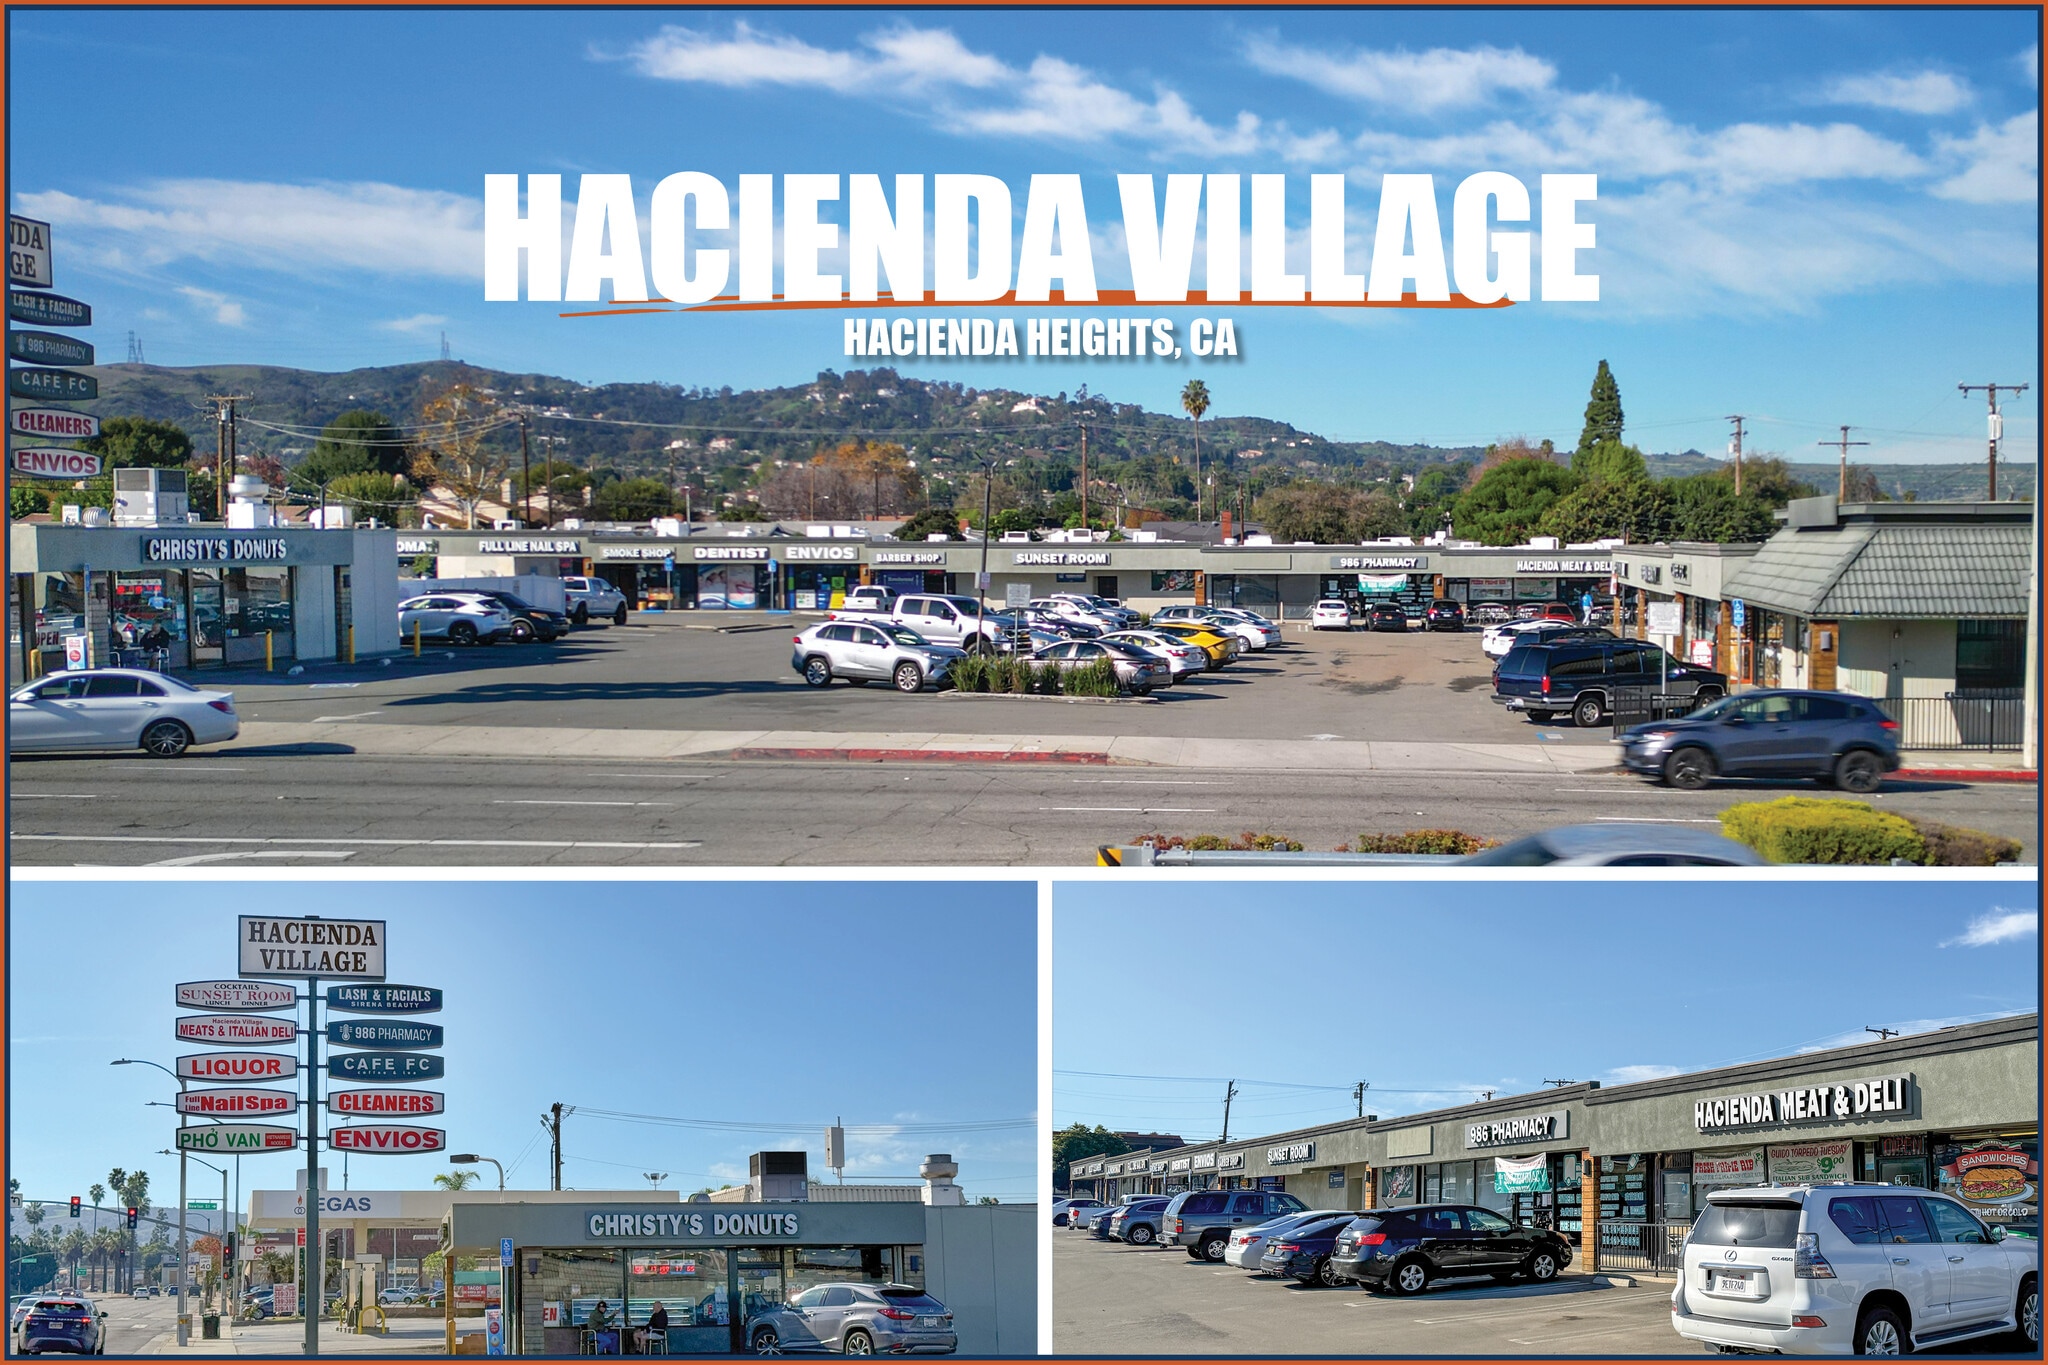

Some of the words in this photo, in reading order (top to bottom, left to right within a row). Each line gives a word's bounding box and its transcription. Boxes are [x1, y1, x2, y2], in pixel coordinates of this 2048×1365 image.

[13, 293, 36, 309] LASH
[39, 298, 46, 311] &
[49, 299, 83, 317] FACIALS
[28, 337, 44, 353] 986
[45, 341, 87, 360] PHARMACY
[21, 371, 61, 389] CAFE
[69, 377, 87, 392] FC
[19, 411, 93, 436] CLEANERS
[17, 451, 97, 474] ENVIOS
[149, 538, 228, 561] CHRISTY'S
[234, 538, 287, 559] DONUTS
[479, 541, 504, 552] FULL
[506, 541, 528, 552] LINE
[530, 541, 554, 552] NAIL
[556, 541, 577, 552] SPA
[602, 547, 640, 558] SMOKE
[641, 548, 671, 558] SHOP
[694, 547, 769, 559] DENTIST
[785, 547, 855, 560] ENVIOS
[876, 553, 912, 563] BARBER
[914, 553, 940, 563] SHOP
[1016, 553, 1065, 564] SUNSET
[1068, 553, 1107, 564] ROOM
[1340, 557, 1360, 568] 986
[1362, 557, 1417, 568] PHARMACY
[1517, 560, 1559, 571] HACIENDA
[1561, 560, 1584, 571] MEAT
[1585, 561, 1592, 571] &
[248, 921, 378, 946] HACIENDA
[259, 948, 367, 973] VILLAGE
[214, 983, 260, 991] COCKTAILS
[181, 989, 243, 1001] SUNSET
[247, 991, 291, 1002] ROOM
[338, 988, 368, 1001] LASH
[373, 989, 381, 1001] &
[386, 989, 431, 1002] FACIALS
[180, 1024, 215, 1037] MEATS
[218, 1025, 225, 1037] &
[229, 1025, 268, 1038] ITALIAN
[271, 1026, 294, 1038] DELI
[355, 1027, 376, 1039] 986
[378, 1027, 433, 1041] PHARMACY
[192, 1059, 282, 1076] LIQUOR
[343, 1057, 395, 1070] CAFE
[406, 1059, 430, 1071] FC
[185, 1095, 200, 1103] Full
[338, 1094, 434, 1112] CLEANERS
[1694, 1094, 1774, 1128] HACIENDA
[1779, 1087, 1829, 1120] MEAT
[1833, 1085, 1850, 1116] &
[1853, 1078, 1904, 1112] DELI
[1470, 1125, 1489, 1143] 986
[1491, 1116, 1550, 1141] PHARMACY
[225, 1132, 261, 1148] VAN
[335, 1130, 439, 1148] ENVIOS
[1268, 1147, 1288, 1161] SUNSET
[1290, 1144, 1309, 1160] ROOM
[1791, 1146, 1819, 1158] TORPEDO
[1171, 1158, 1191, 1171] DENTIST
[1194, 1152, 1215, 1169] ENVIOS
[1694, 1161, 1715, 1174] FRESH
[1740, 1158, 1754, 1171] RIB
[1961, 1153, 2027, 1167] SANDWICHES
[1812, 1173, 1848, 1181] SANDWICH
[1982, 1207, 1997, 1217] HOT
[589, 1213, 703, 1236] CHRISTY'S
[713, 1213, 799, 1236] DONUTS
